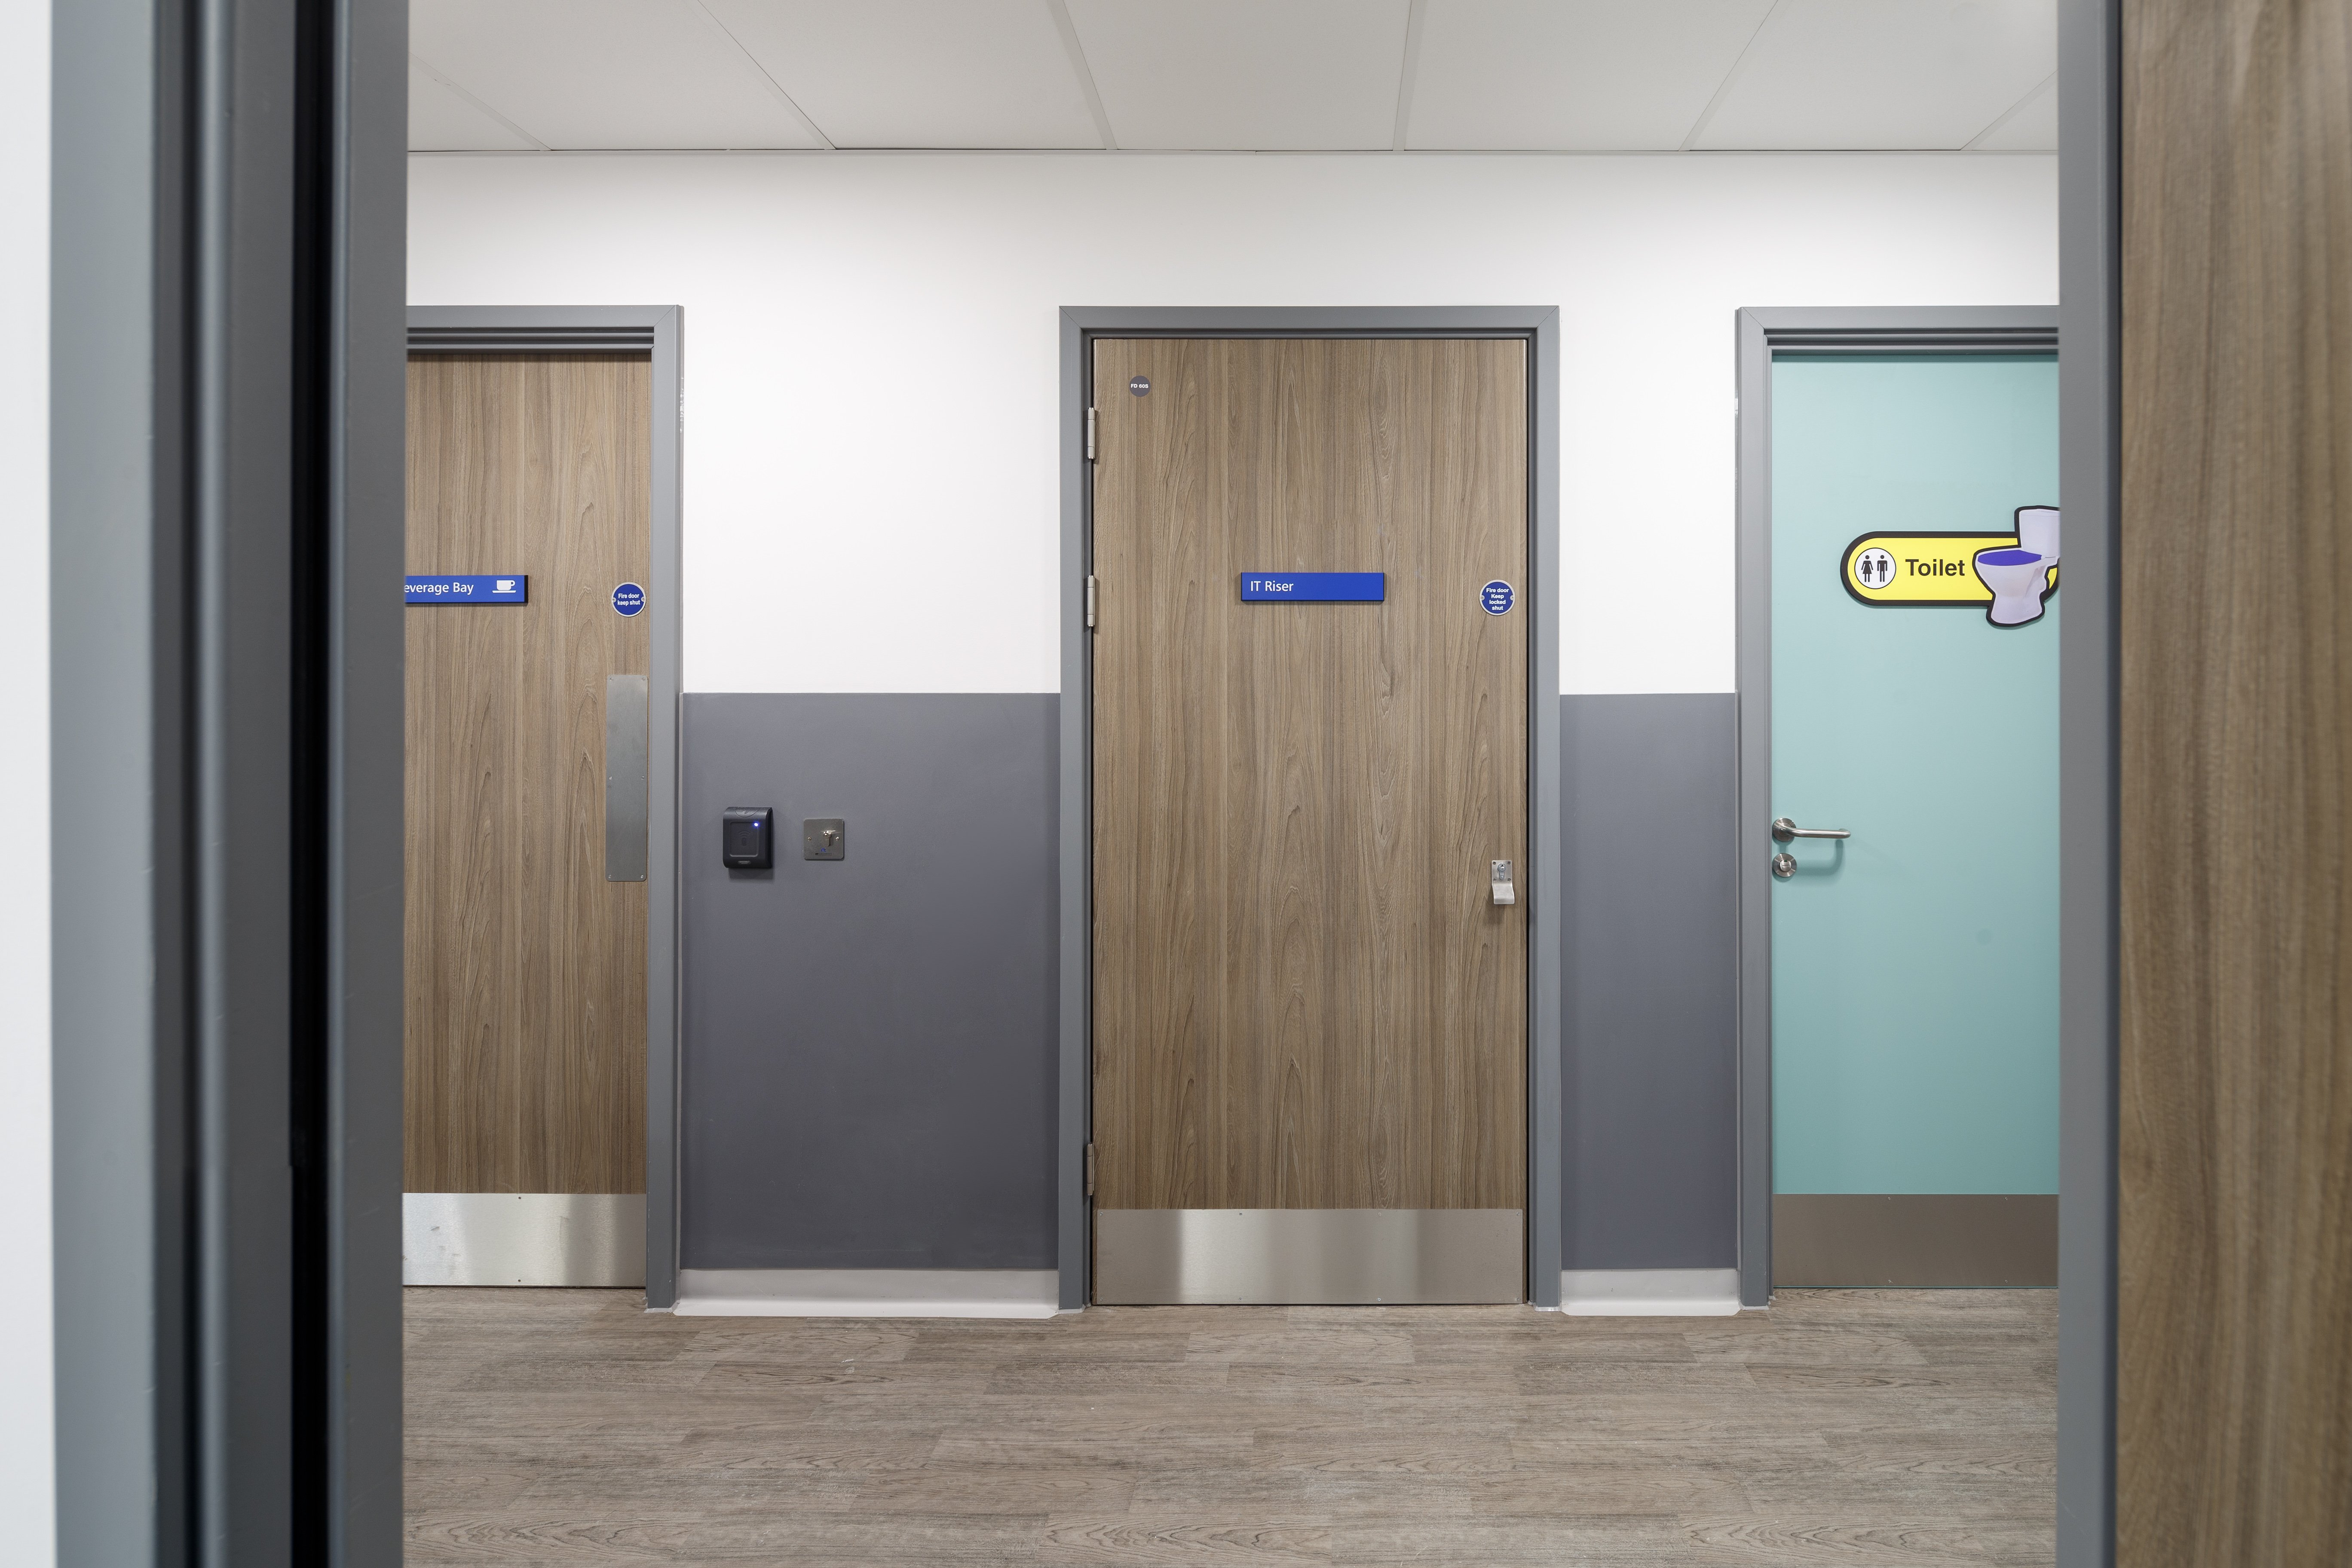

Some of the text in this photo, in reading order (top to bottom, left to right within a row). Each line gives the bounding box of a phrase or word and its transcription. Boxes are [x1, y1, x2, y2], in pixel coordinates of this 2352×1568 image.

[1905, 559, 1965, 576] Toilet
[404, 582, 474, 595] everage Bay
[1251, 580, 1294, 591] IT Riser
